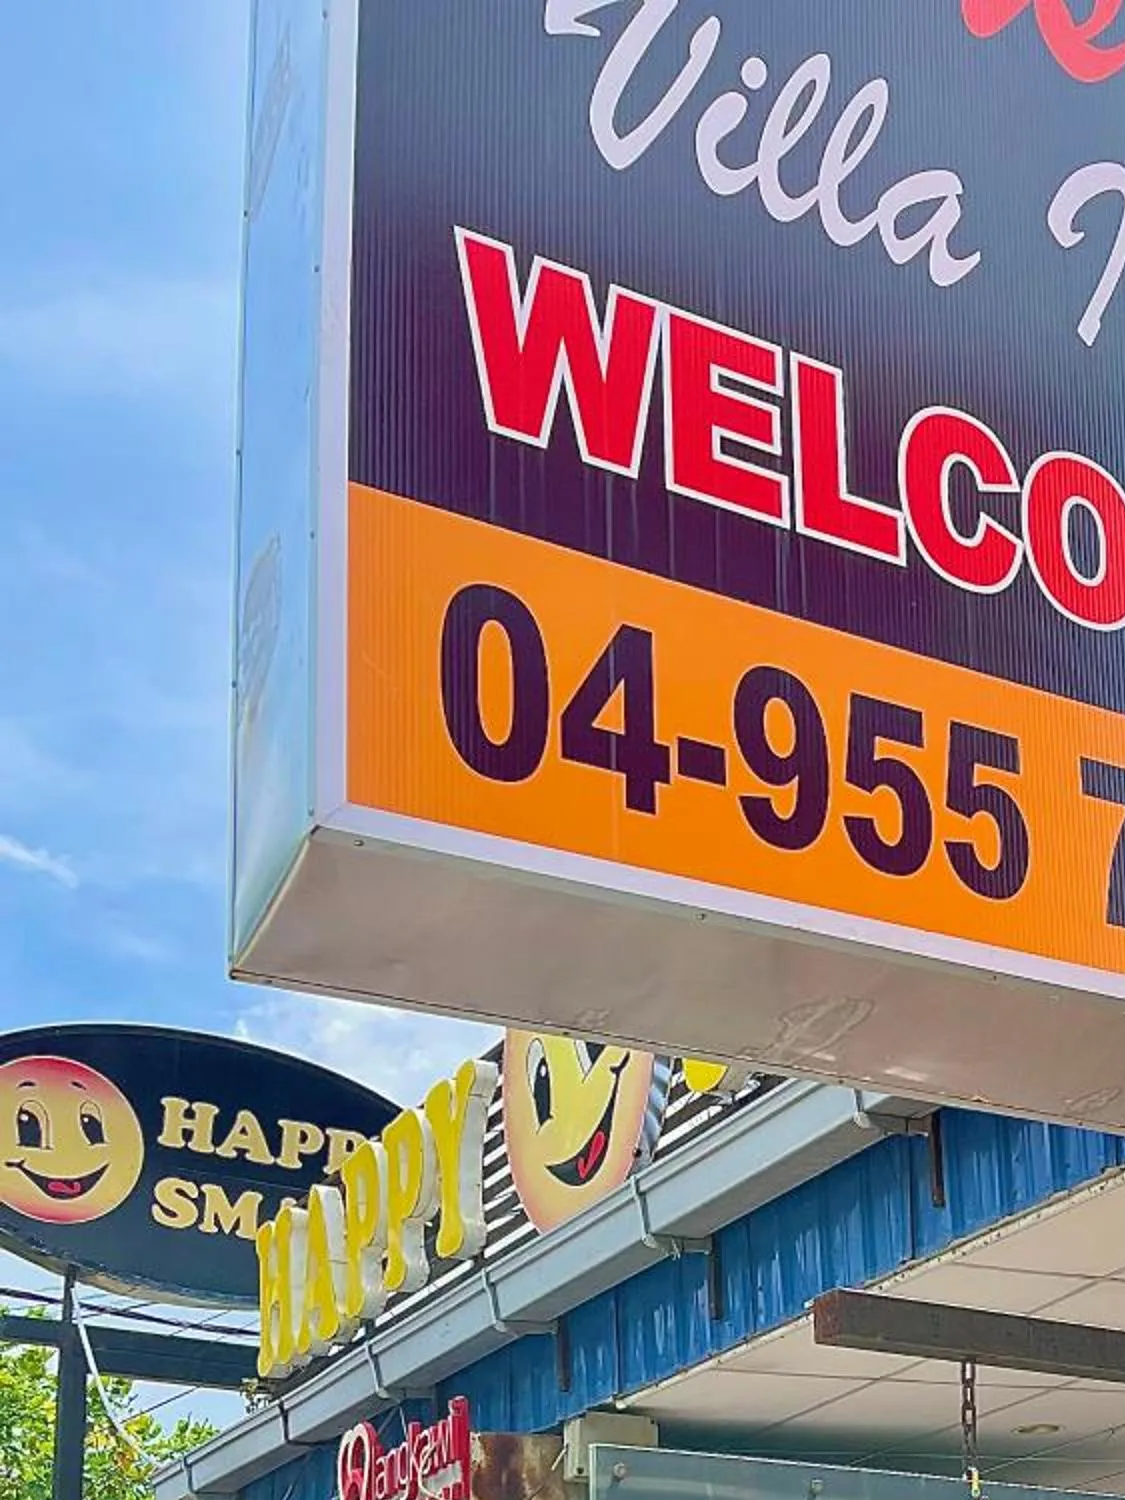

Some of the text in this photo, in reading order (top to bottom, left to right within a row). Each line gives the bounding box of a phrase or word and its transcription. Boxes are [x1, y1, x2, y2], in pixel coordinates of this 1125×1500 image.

[545, 0, 980, 287] Villa
[438, 582, 1031, 901] 04-955
[157, 1096, 378, 1175] HAPP
[256, 1059, 497, 1379] HAPPY
